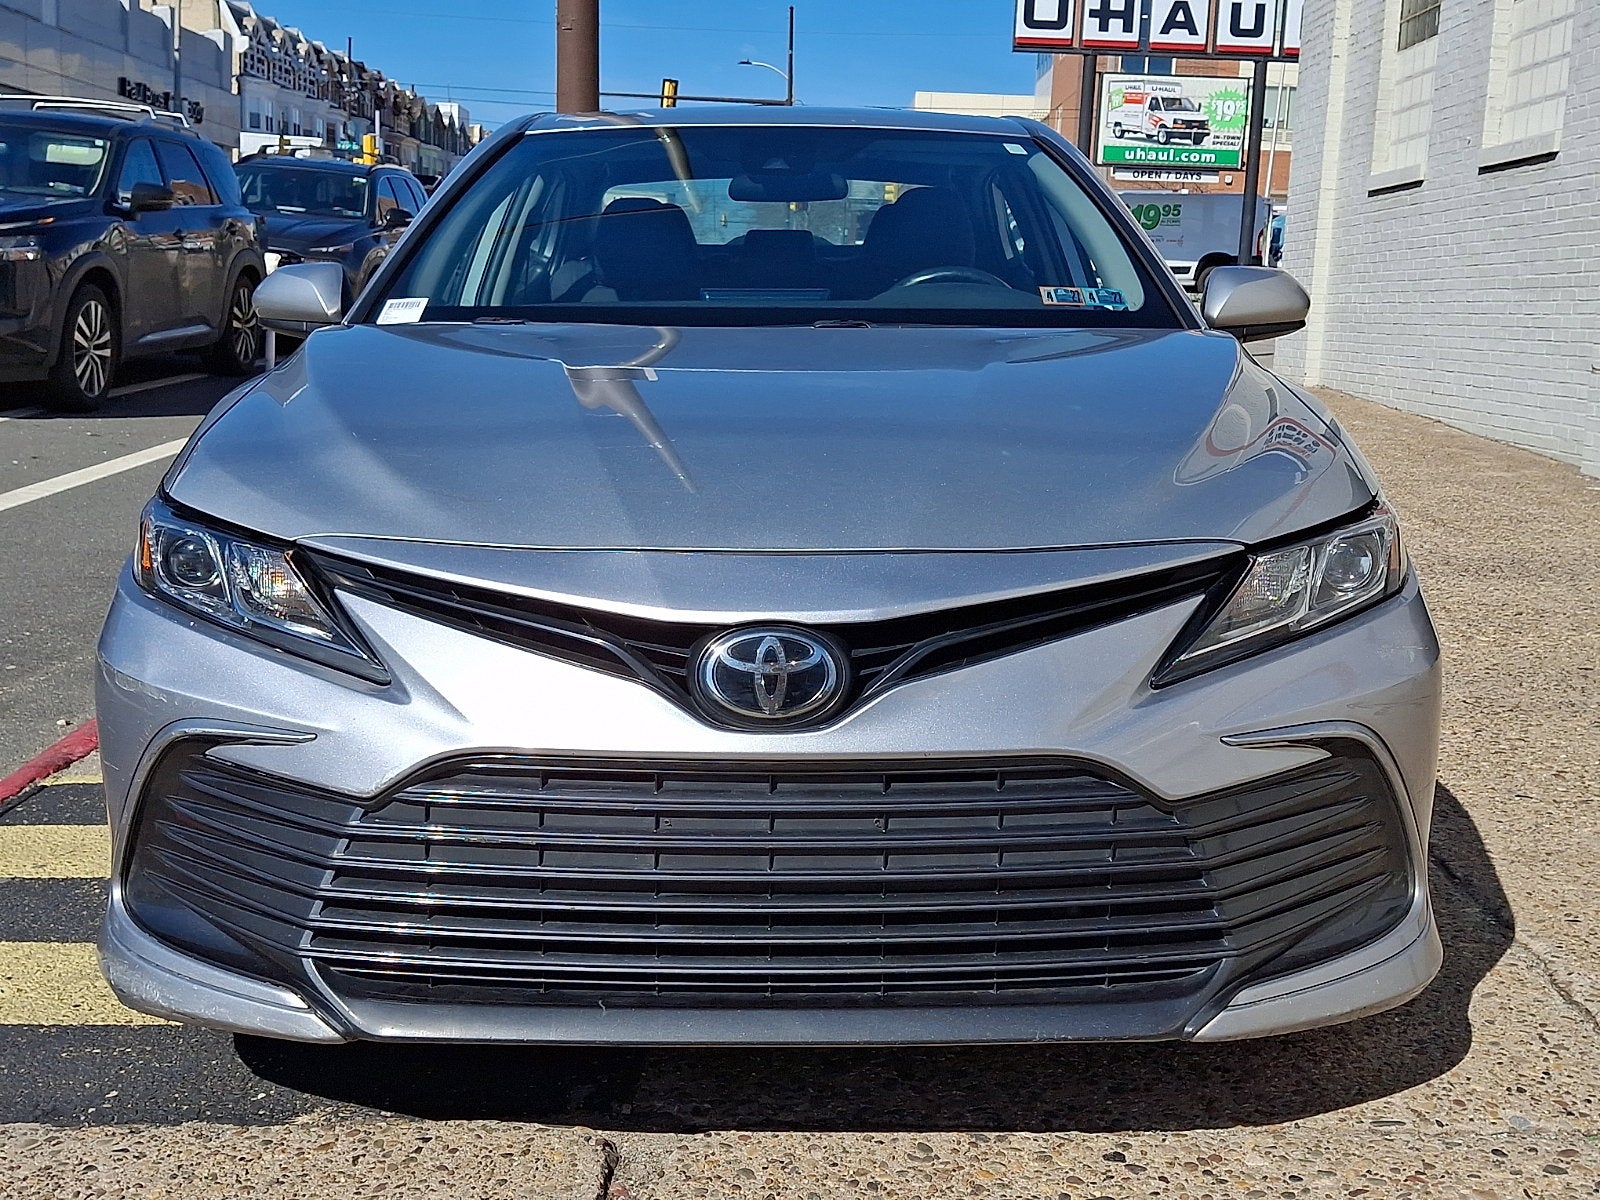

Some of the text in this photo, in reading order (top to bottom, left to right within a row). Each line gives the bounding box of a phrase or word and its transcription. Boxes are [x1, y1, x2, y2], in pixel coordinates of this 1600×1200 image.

[1023, 0, 1267, 38] U-HAU
[1151, 85, 1177, 93] U-HAUL
[1124, 147, 1217, 163] uhaul.com
[1132, 170, 1202, 180] OPEN 7 DAYS
